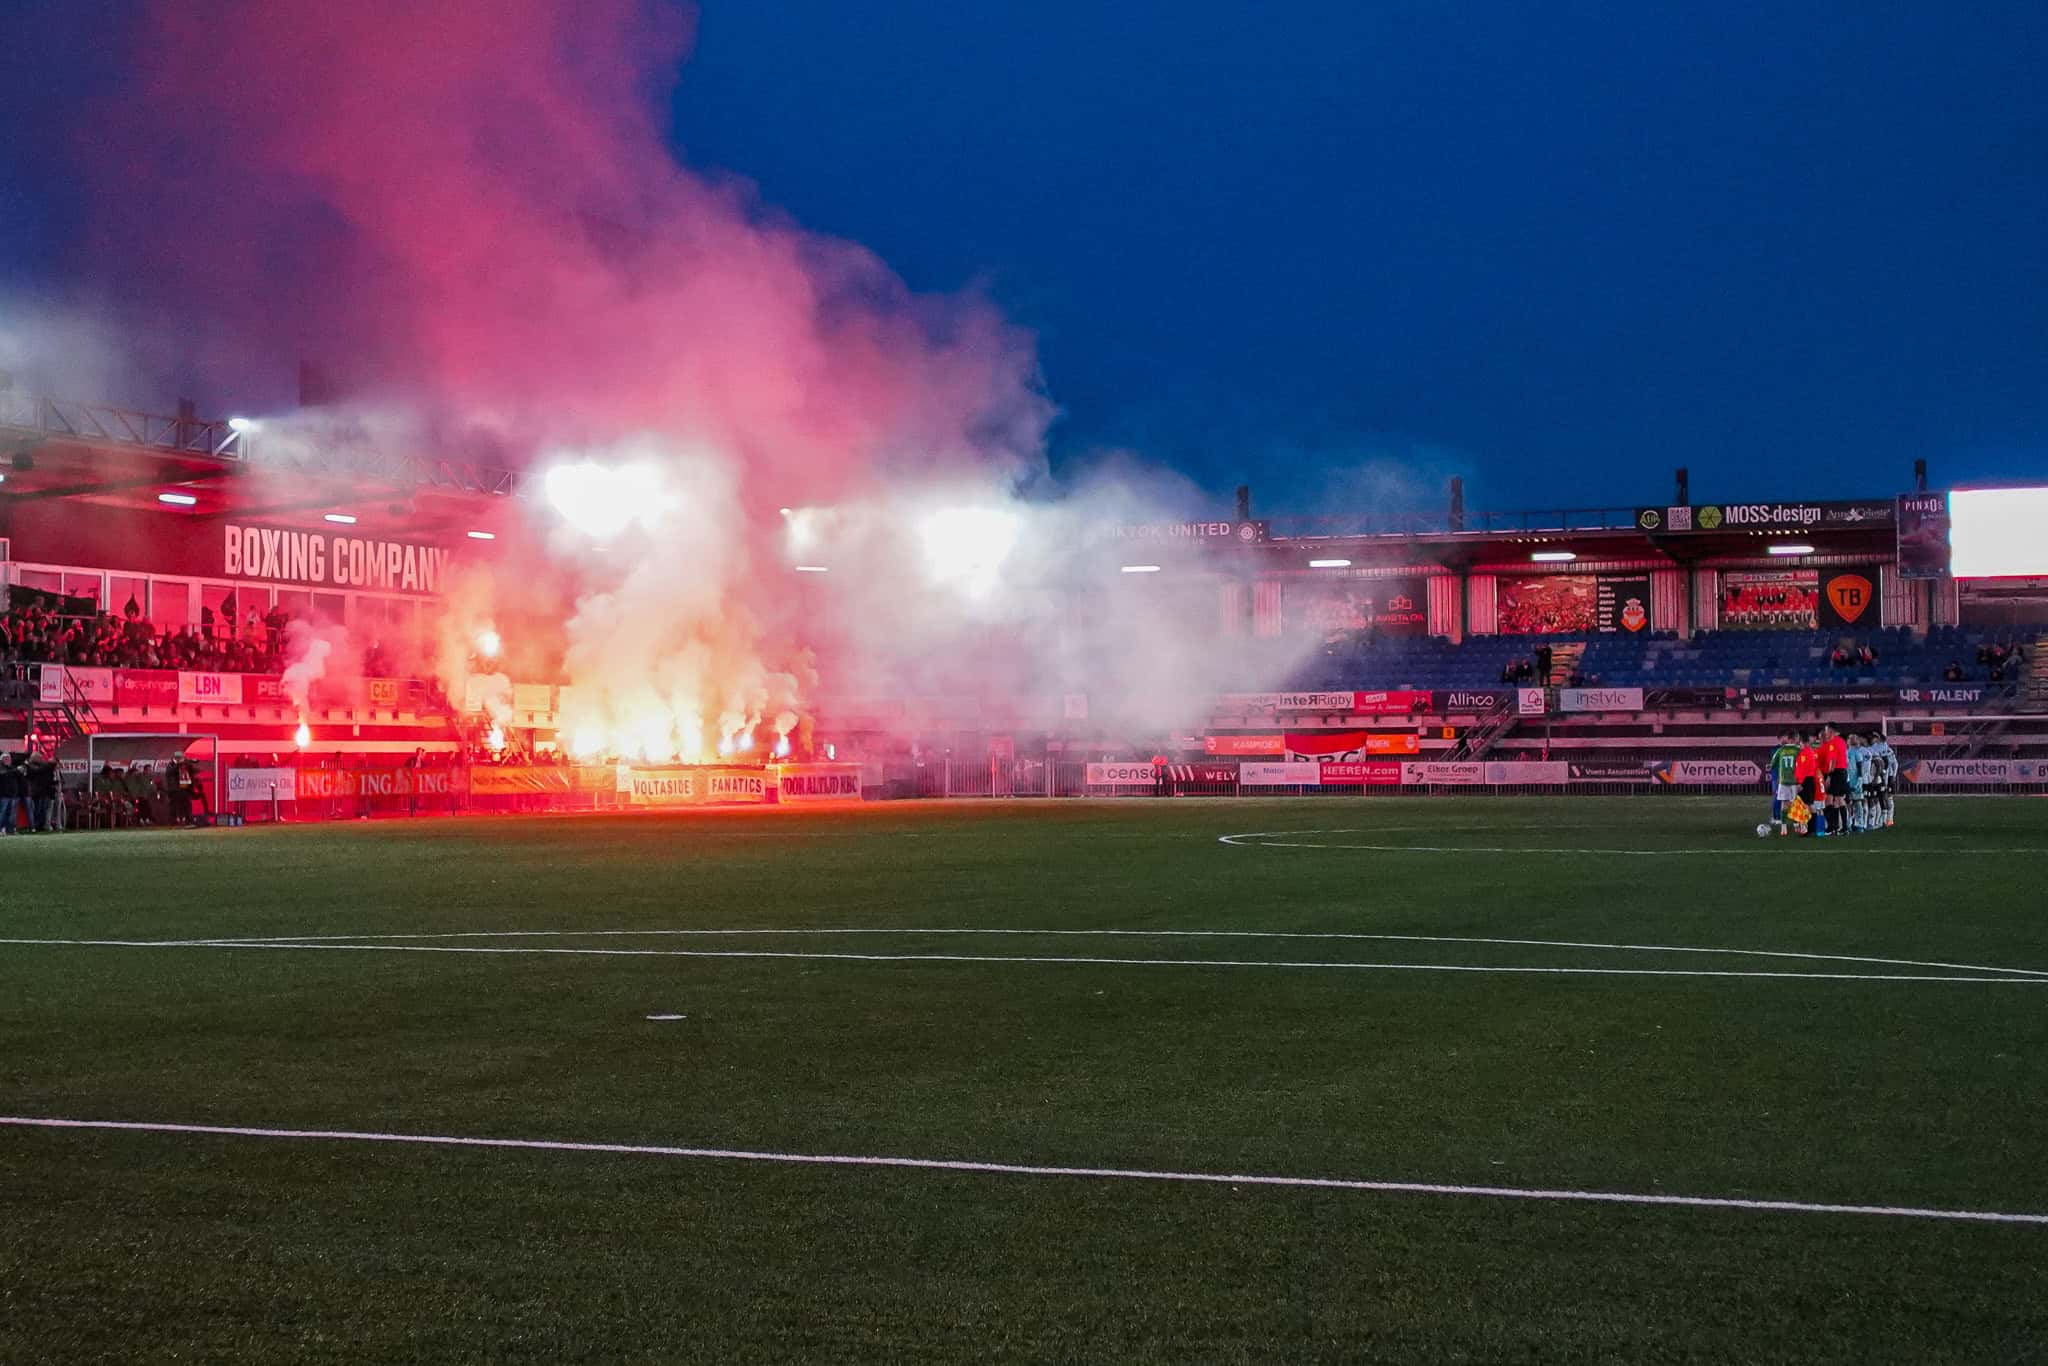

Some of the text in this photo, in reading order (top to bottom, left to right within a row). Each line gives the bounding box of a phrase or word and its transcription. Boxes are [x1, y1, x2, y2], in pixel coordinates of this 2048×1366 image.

[1725, 505, 1821, 525] MOSS-design
[1168, 523, 1231, 536] UNITED
[332, 537, 449, 593] COMPANY
[1837, 588, 1861, 606] TB
[195, 675, 222, 696] LBN
[1753, 693, 1774, 702] VAN
[1929, 689, 1981, 701] TALENT
[1205, 771, 1237, 781] WELY
[1322, 765, 1399, 776] HEEREN.com
[1680, 762, 1757, 777] Vermetten
[1927, 760, 2007, 776] Vermetten
[300, 778, 332, 796] ING
[360, 775, 392, 795] ING
[418, 773, 449, 794] ING
[633, 777, 763, 796] VOLTASIDE FANATICS
